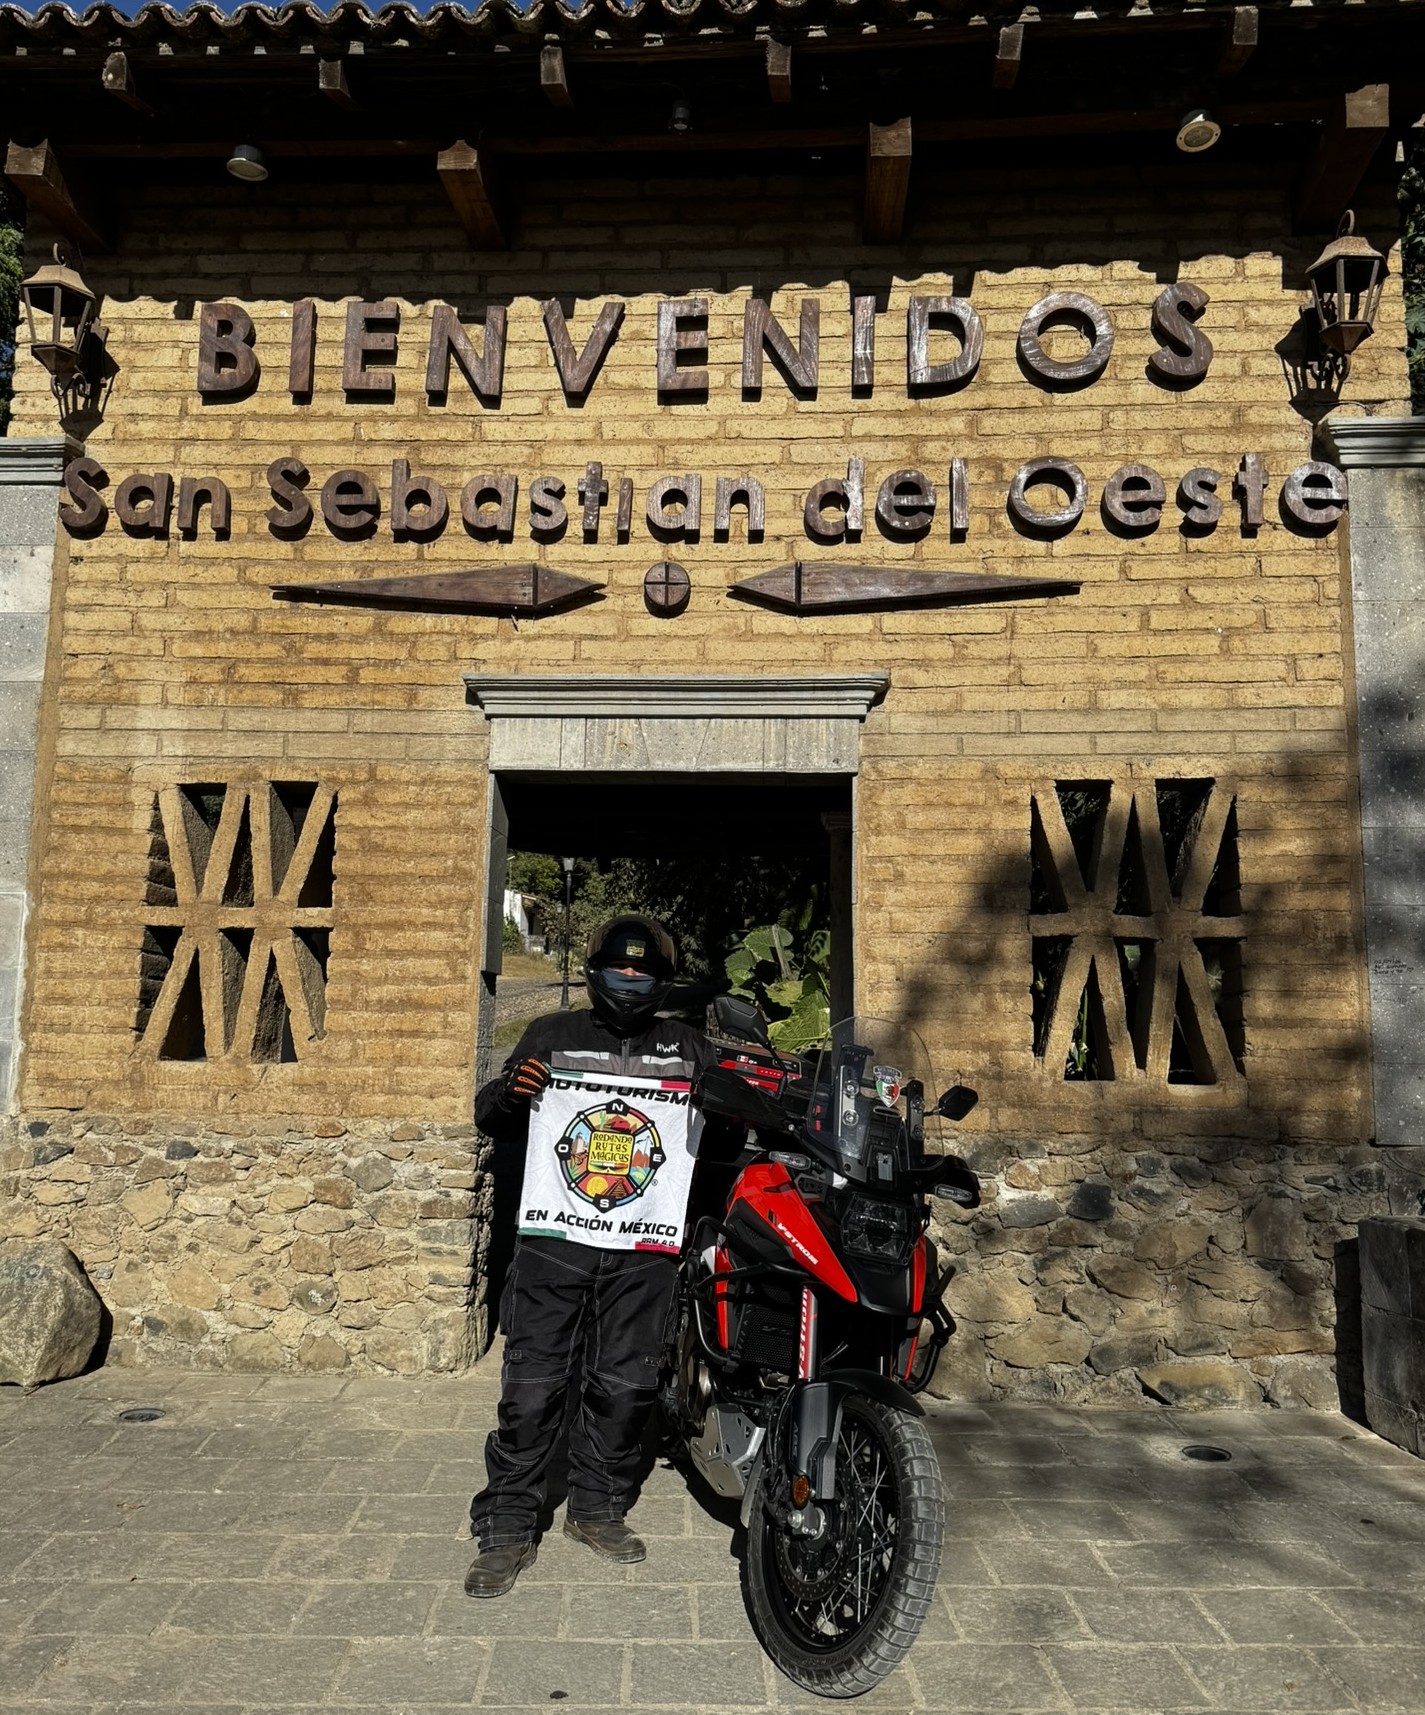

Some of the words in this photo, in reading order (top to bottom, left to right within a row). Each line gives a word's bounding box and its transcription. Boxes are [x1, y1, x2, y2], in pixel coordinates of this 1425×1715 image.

[197, 281, 1214, 399] BIENVENIDOS
[59, 456, 231, 535] San
[264, 456, 766, 535] Sebastian
[804, 456, 969, 534] del
[1008, 453, 1347, 533] Oeste
[612, 1103, 624, 1112] N
[557, 1144, 570, 1153] O
[653, 1154, 662, 1163] E
[600, 1199, 610, 1208] S
[525, 1209, 549, 1221] EN
[553, 1211, 614, 1232] ACCIÓN
[618, 1218, 678, 1237] MÉXICO
